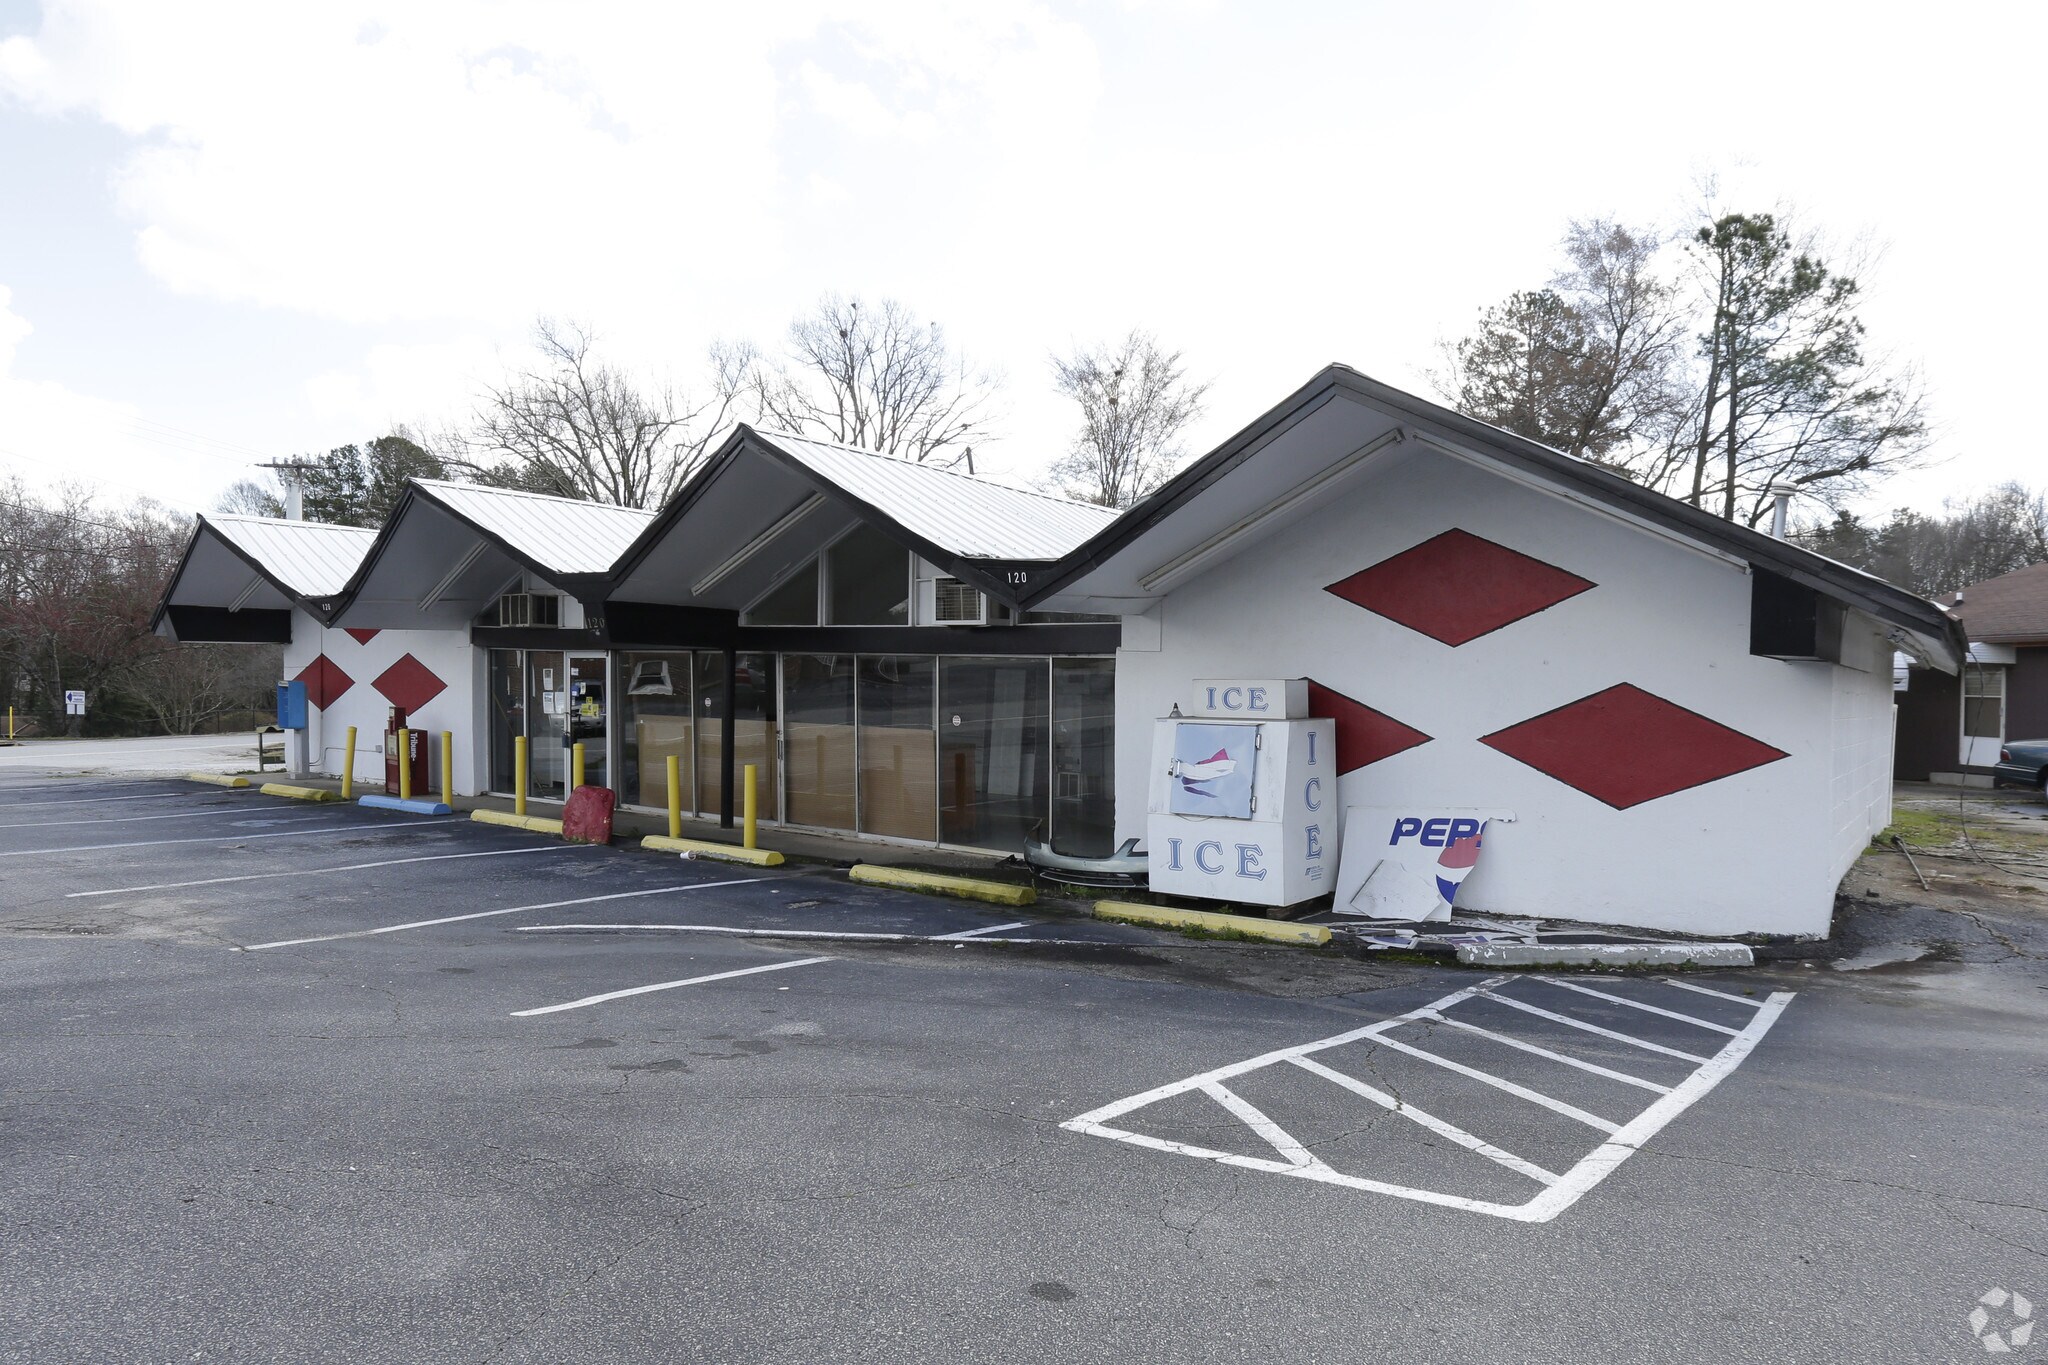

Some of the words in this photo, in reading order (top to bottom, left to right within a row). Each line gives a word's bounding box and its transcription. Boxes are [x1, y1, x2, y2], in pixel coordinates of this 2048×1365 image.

[1007, 571, 1028, 583] 120
[322, 603, 331, 611] 120
[587, 617, 605, 629] 120
[1206, 686, 1269, 712] ICE
[1304, 731, 1322, 861] ICE
[1168, 837, 1268, 881] ICE
